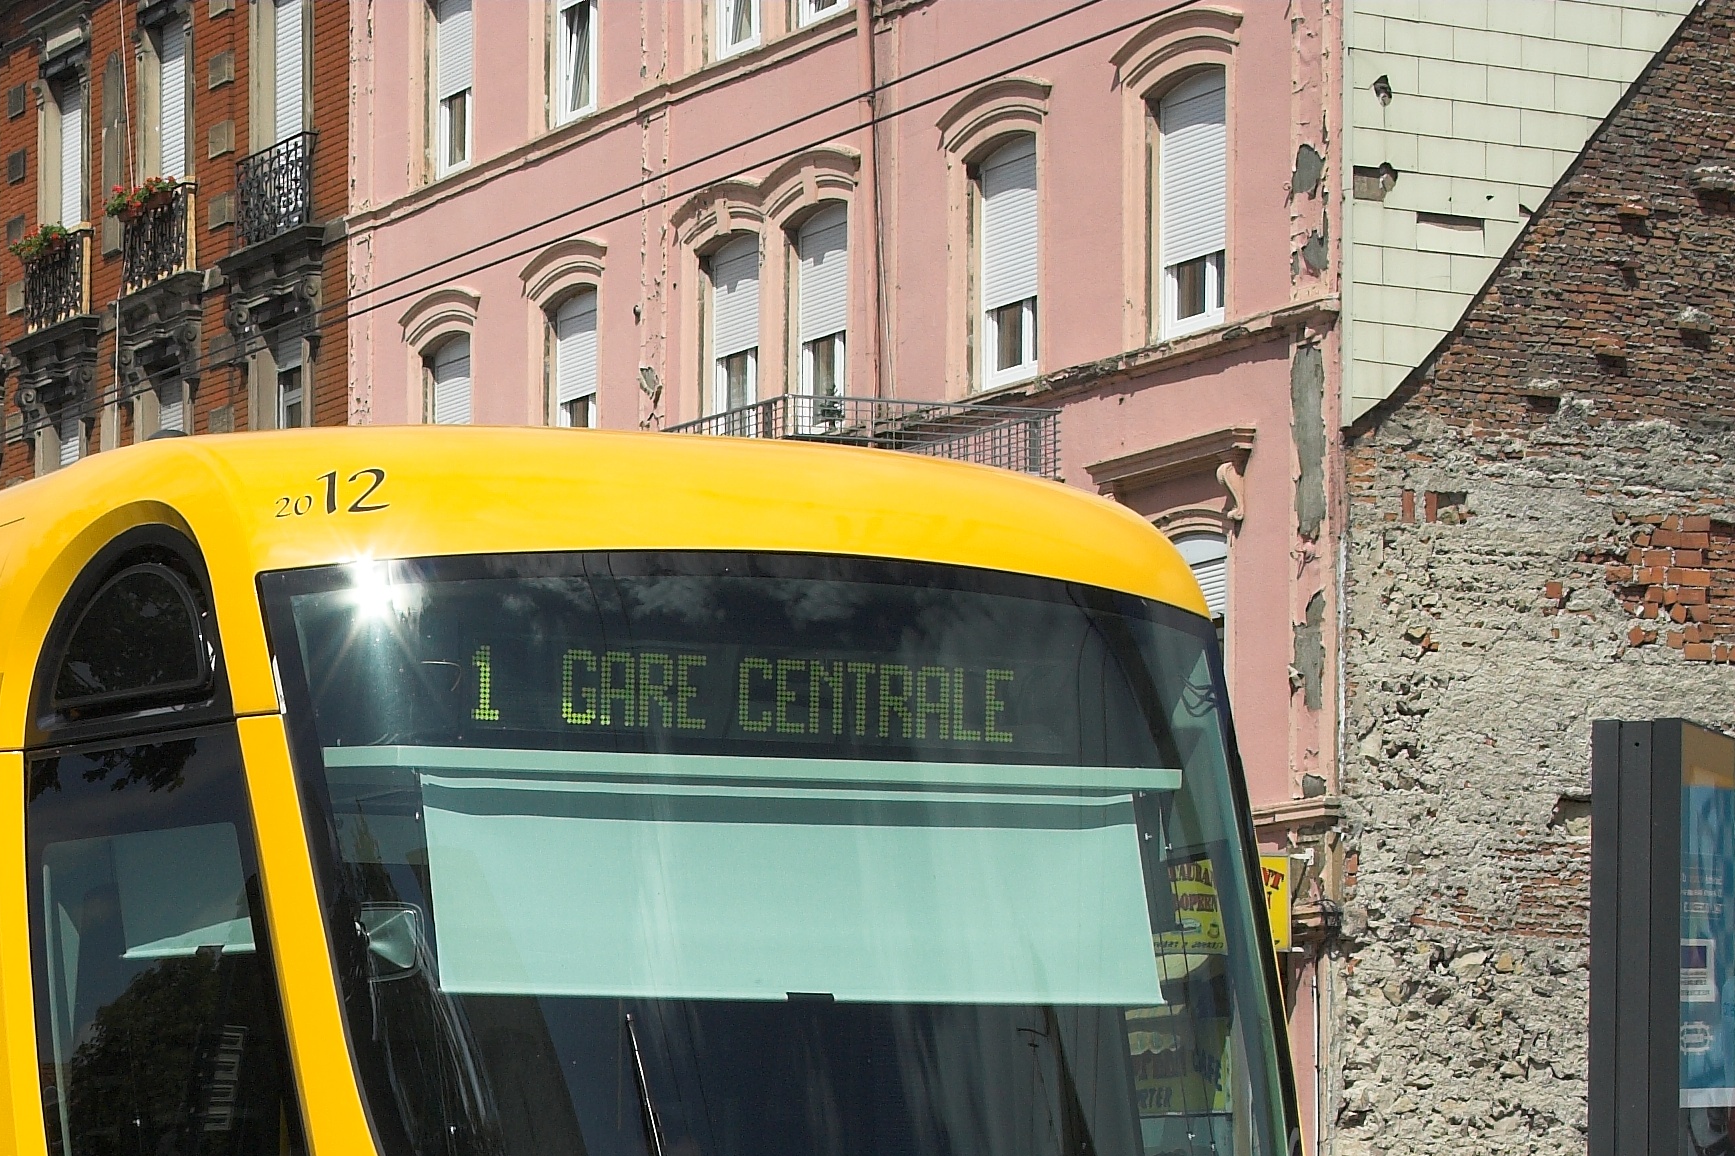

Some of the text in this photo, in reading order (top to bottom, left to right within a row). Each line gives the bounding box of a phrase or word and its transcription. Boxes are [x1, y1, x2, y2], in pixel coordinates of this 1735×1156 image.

[471, 645, 1014, 743] 1 GARE CENTRALE
